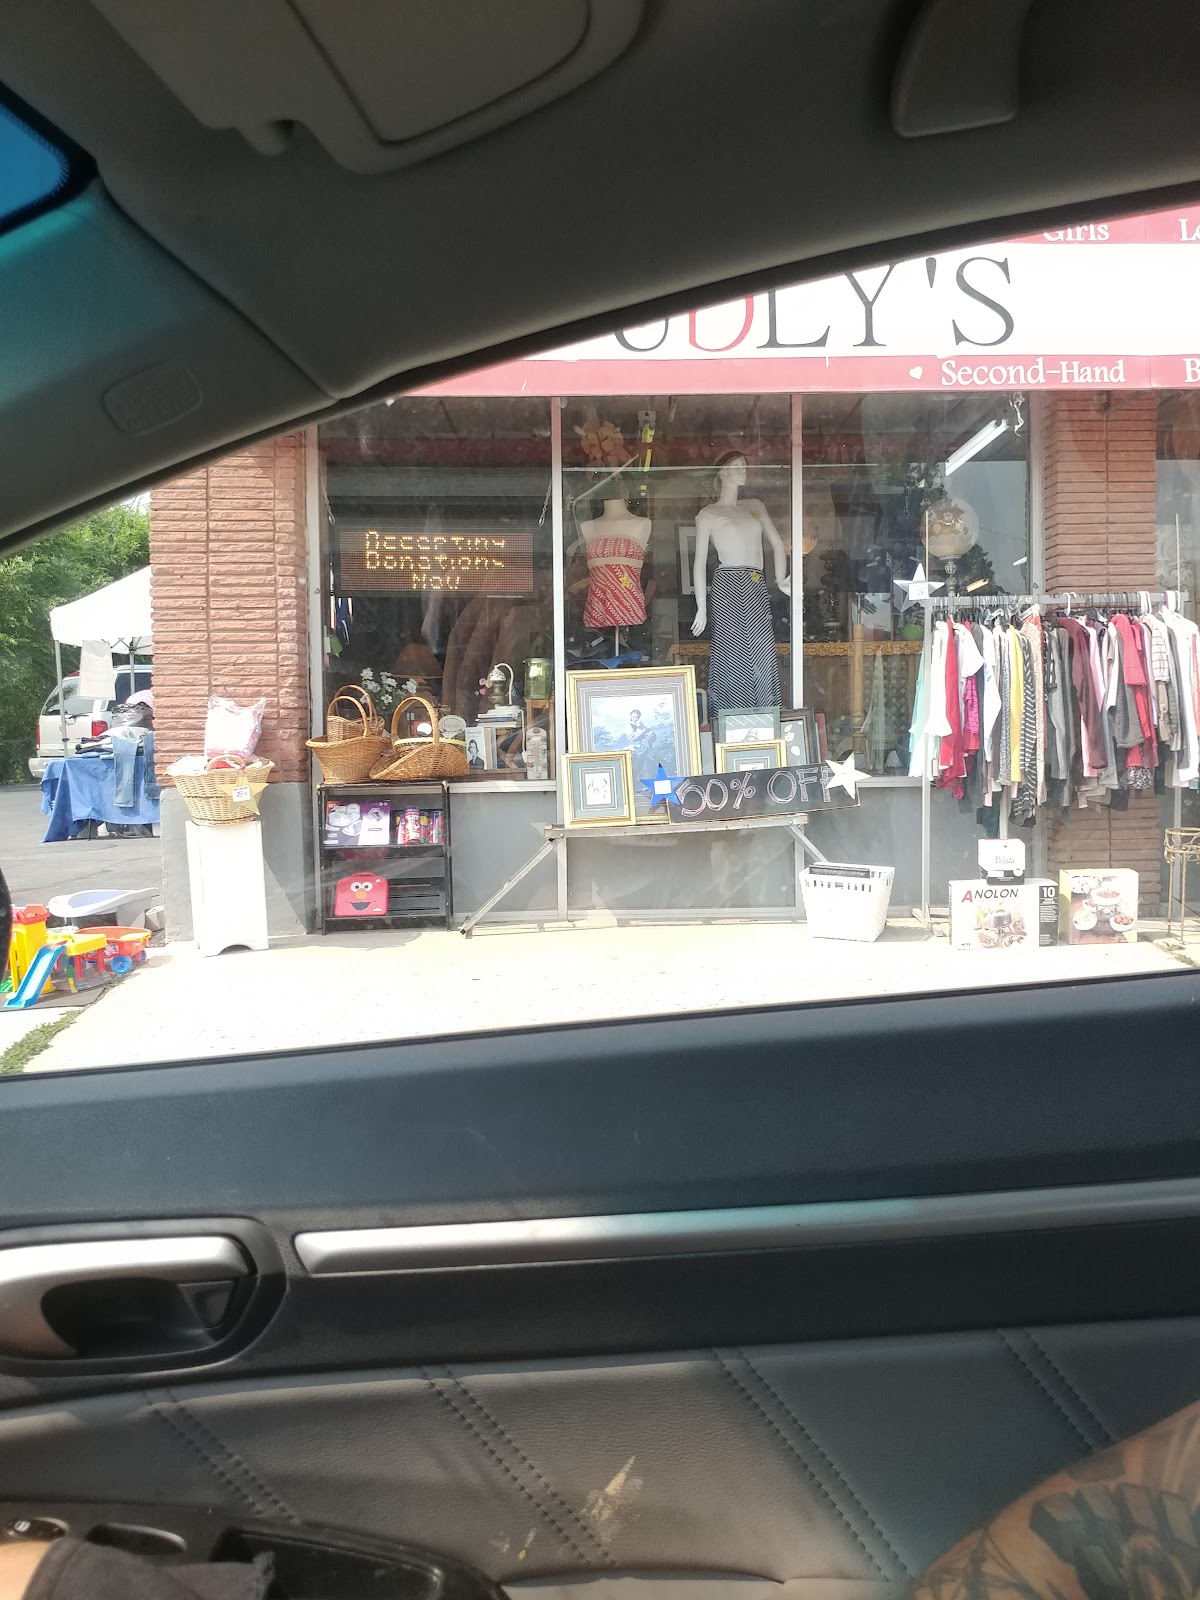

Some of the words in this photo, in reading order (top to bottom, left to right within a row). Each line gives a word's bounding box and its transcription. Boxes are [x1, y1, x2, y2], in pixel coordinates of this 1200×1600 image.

[941, 357, 1126, 386] Second-Hand
[674, 771, 757, 817] 50%
[961, 888, 1019, 903] ANOLON
[1042, 886, 1056, 898] 10
